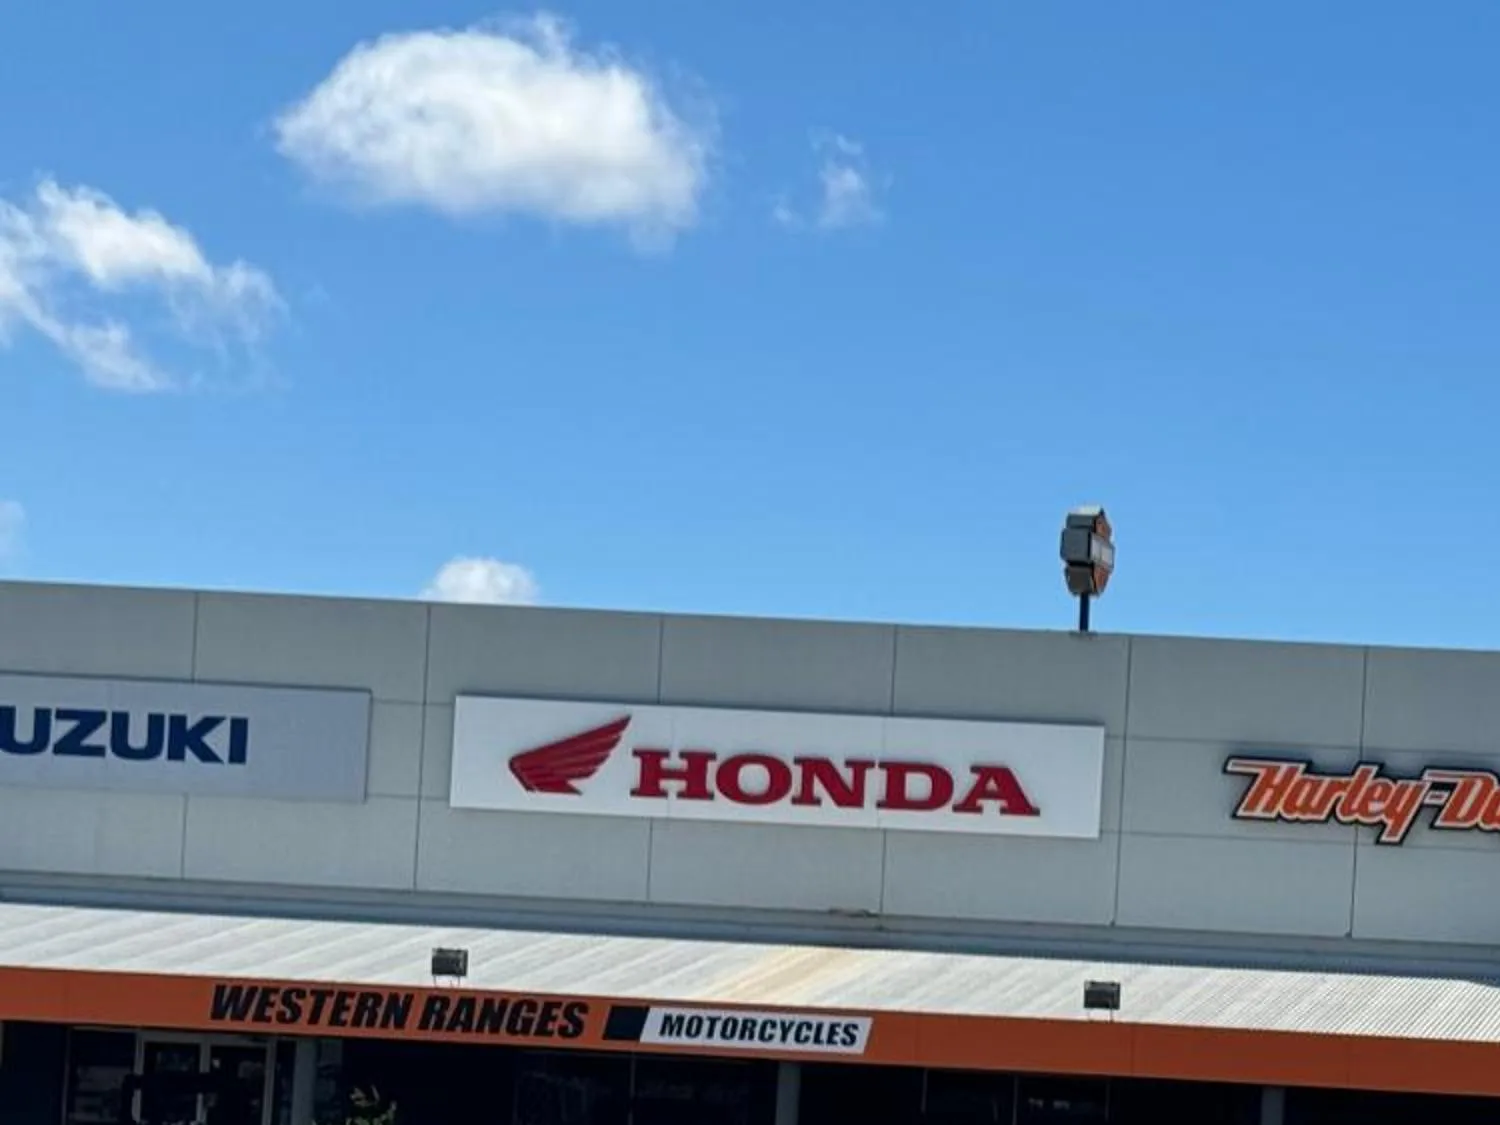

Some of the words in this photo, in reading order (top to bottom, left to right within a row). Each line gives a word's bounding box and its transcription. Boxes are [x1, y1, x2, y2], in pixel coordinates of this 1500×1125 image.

[0, 705, 248, 765] UZUKI
[630, 748, 1040, 816] HONDA
[210, 983, 416, 1030] WESTERN
[417, 995, 589, 1040] RANGES
[658, 1013, 859, 1047] MOTORCYCLES
